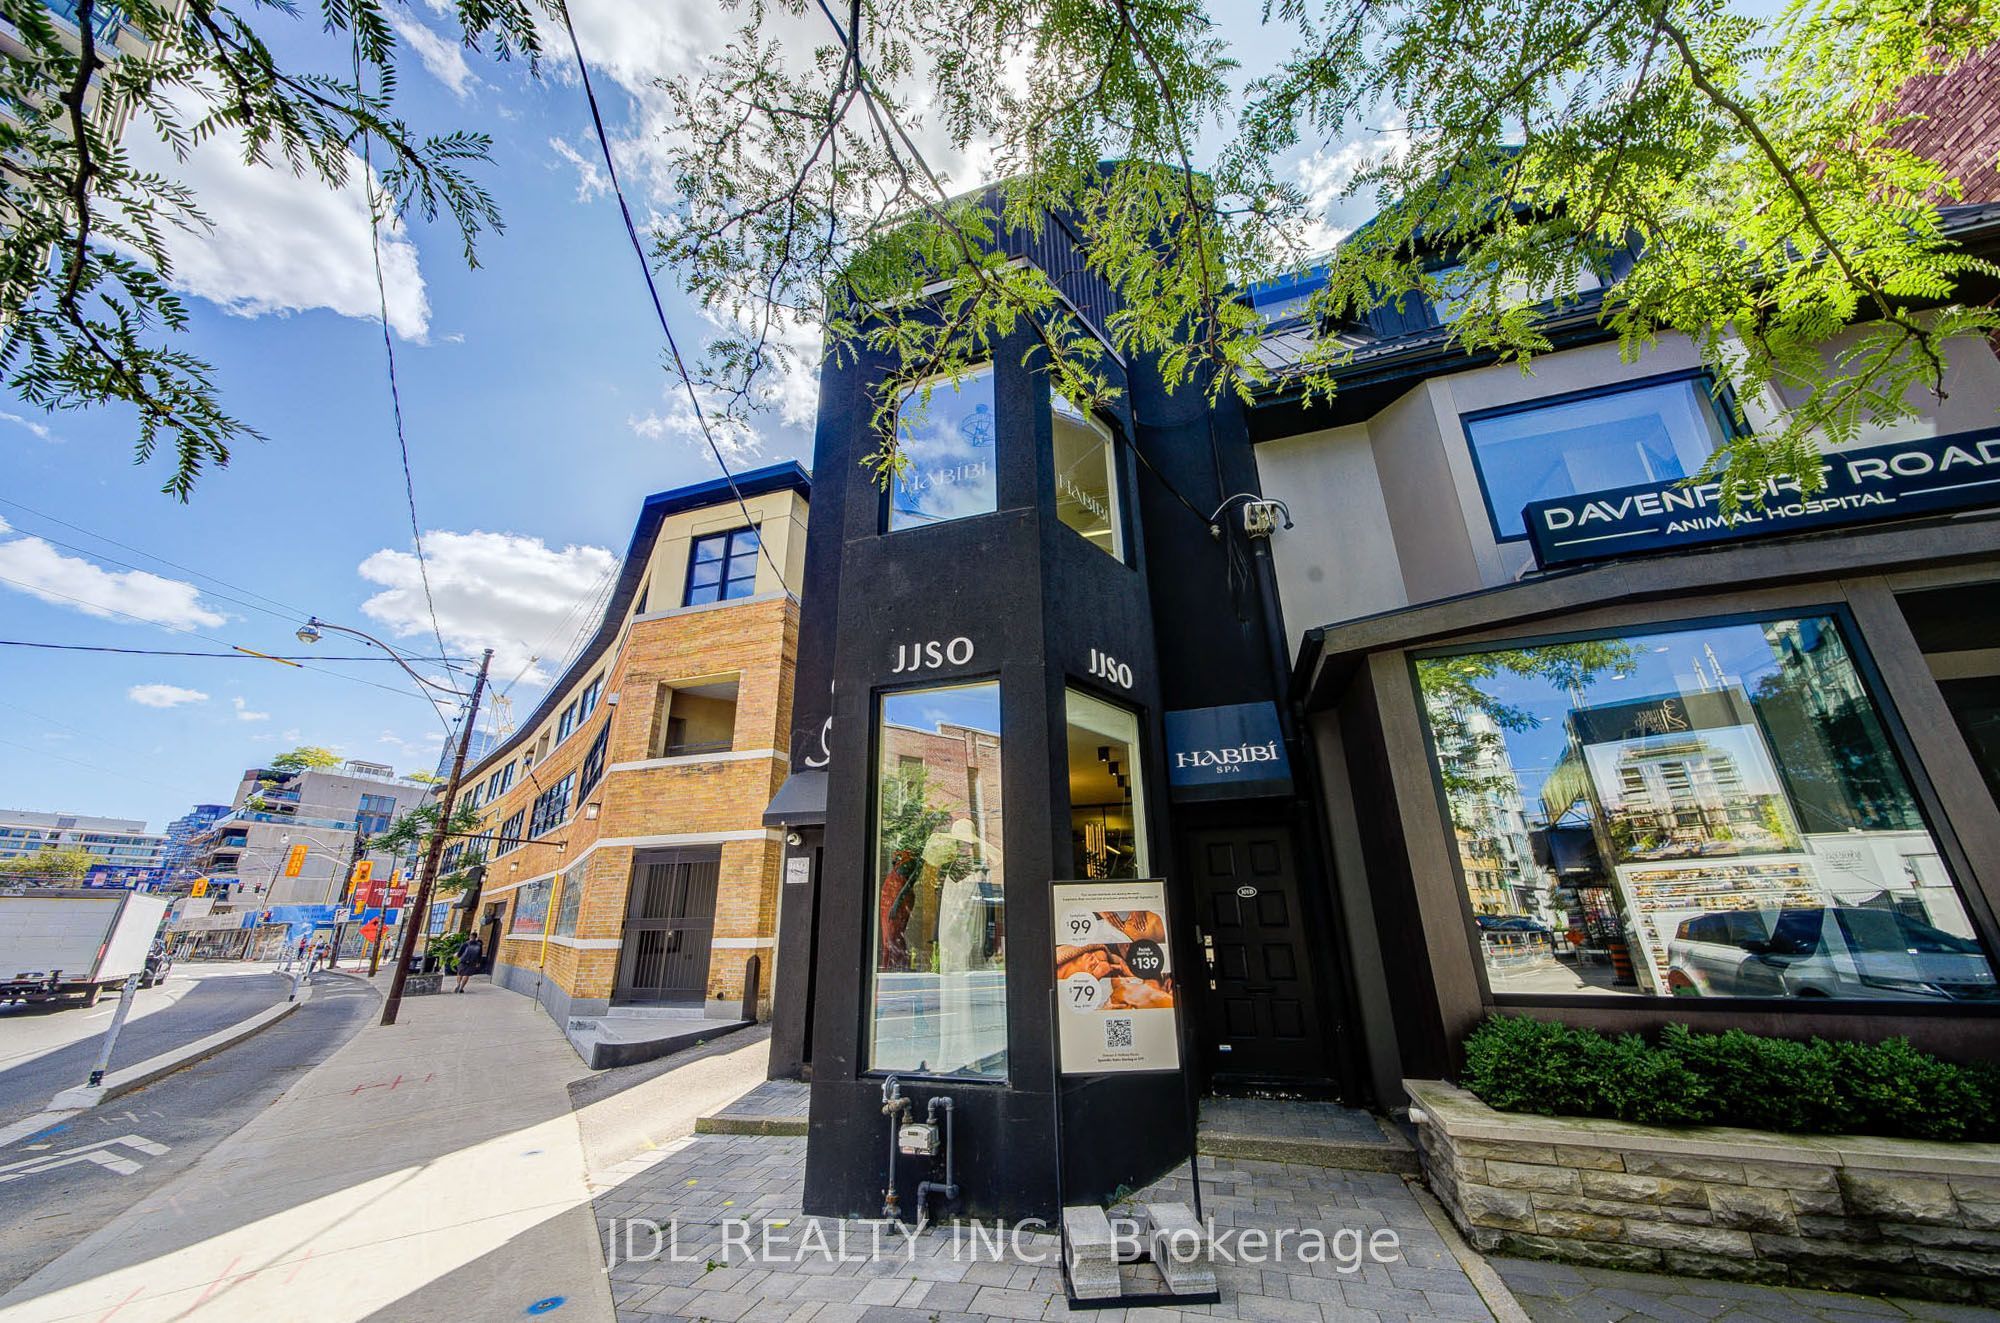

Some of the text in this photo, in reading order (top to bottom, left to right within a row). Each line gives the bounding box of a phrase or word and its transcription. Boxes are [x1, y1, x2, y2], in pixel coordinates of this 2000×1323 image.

[1666, 491, 1897, 535] ANIMAL HOSPITAL
[892, 636, 974, 673] JJSO
[1088, 648, 1133, 689] JJSO
[1216, 765, 1240, 774] SPA
[1132, 957, 1159, 970] $139
